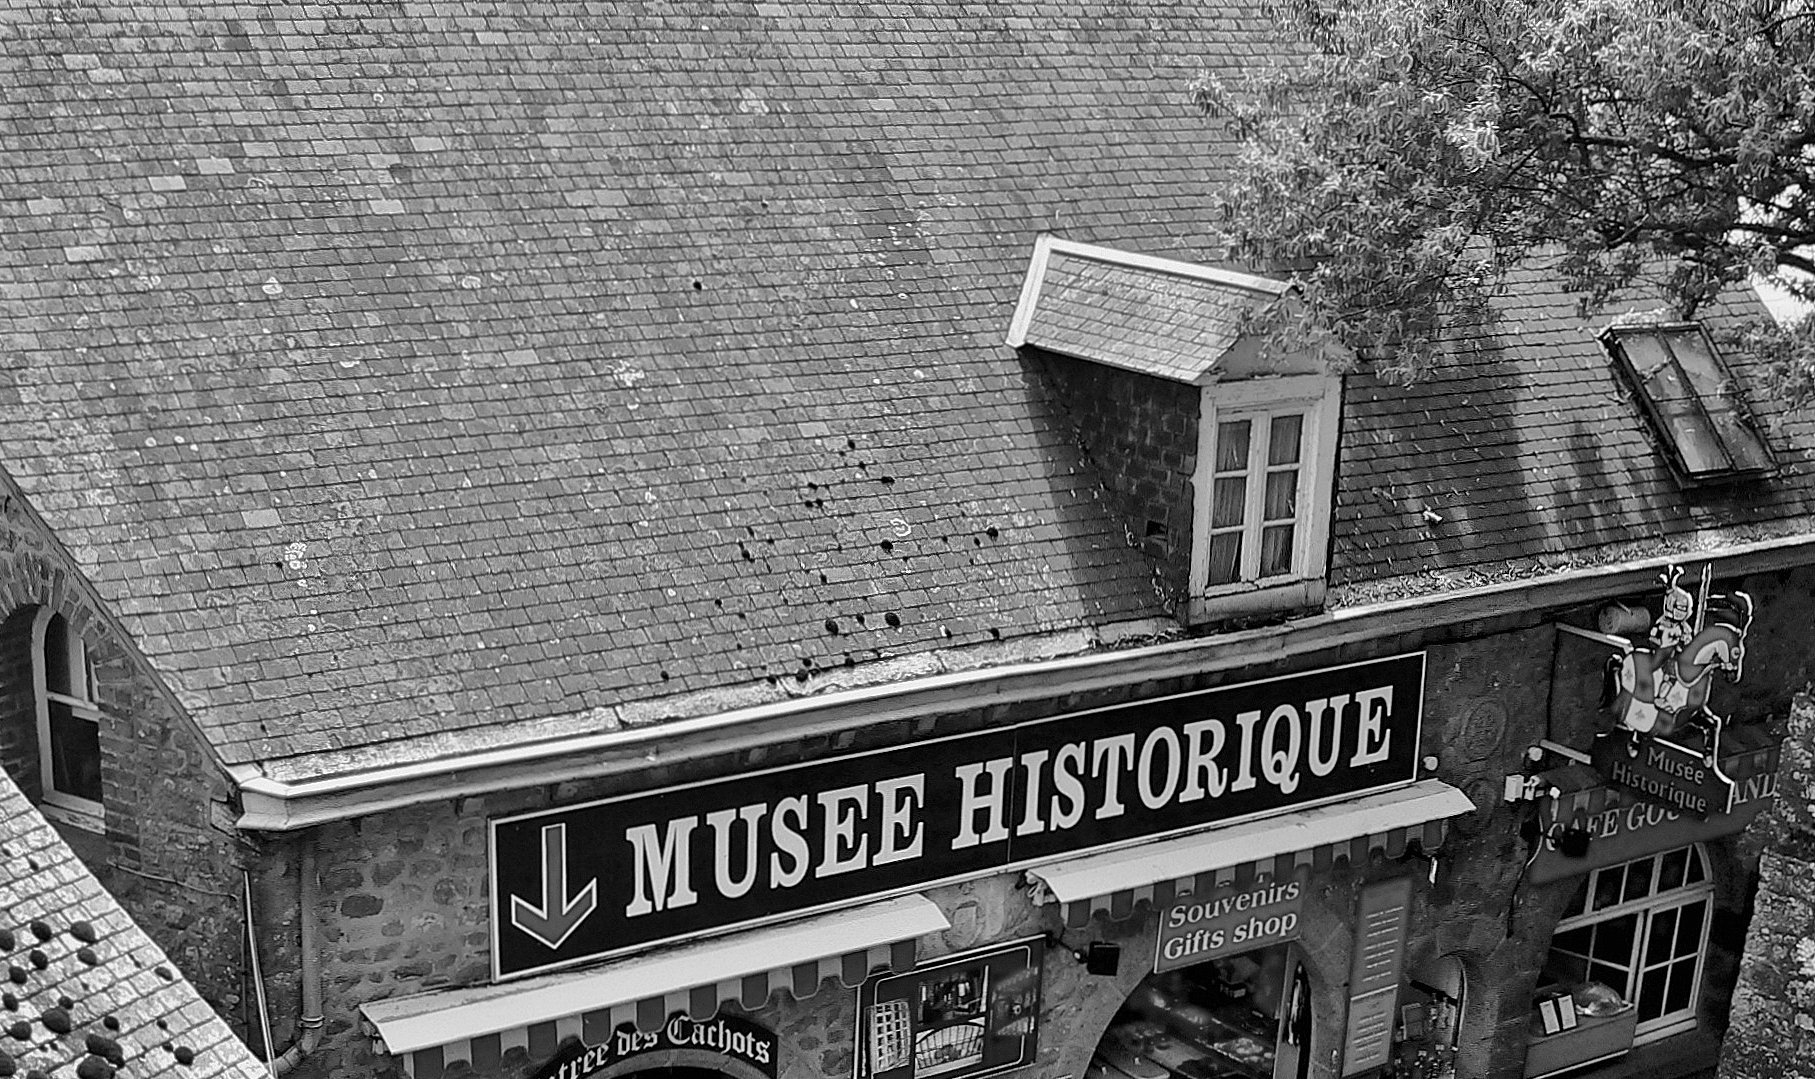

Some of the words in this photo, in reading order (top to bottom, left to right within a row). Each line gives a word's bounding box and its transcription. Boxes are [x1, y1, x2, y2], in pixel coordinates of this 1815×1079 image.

[1612, 761, 1707, 812] Historique
[1647, 747, 1705, 785] Musée
[626, 772, 925, 917] MUSEE
[951, 685, 1394, 851] HISTORIQUE
[1168, 882, 1300, 928] Souvenirs
[1163, 929, 1225, 960] Gifts
[1233, 913, 1298, 943] shop
[666, 1015, 771, 1064] Cachots
